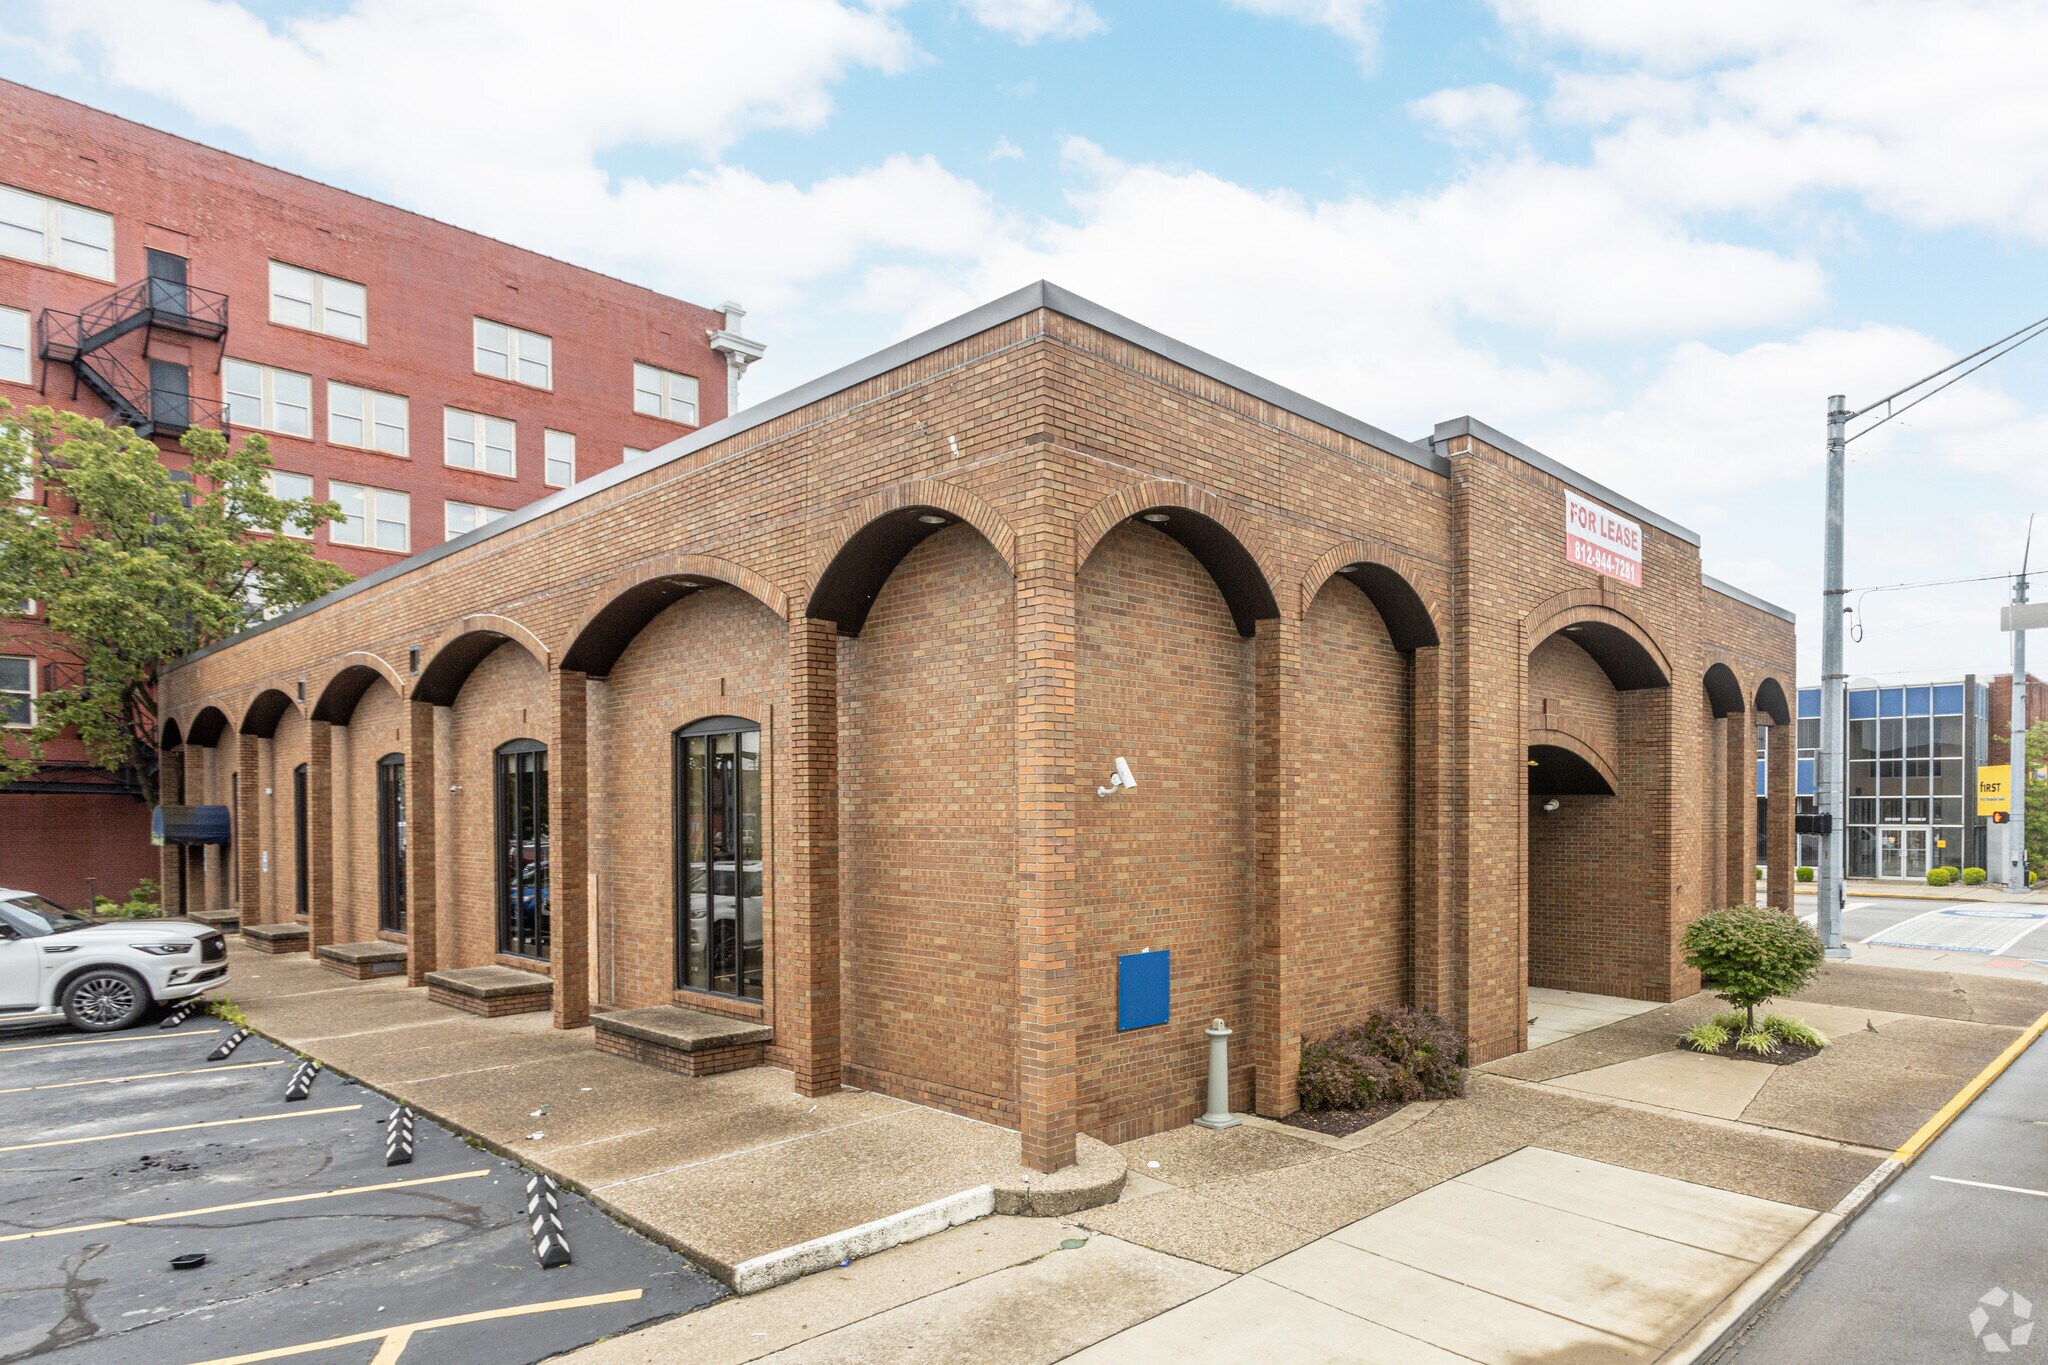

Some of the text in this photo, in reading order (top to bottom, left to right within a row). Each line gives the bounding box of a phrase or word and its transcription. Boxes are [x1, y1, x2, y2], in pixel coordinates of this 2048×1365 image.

[1570, 502, 1638, 551] FOR LEASE
[1574, 540, 1635, 581] 812-944-7281
